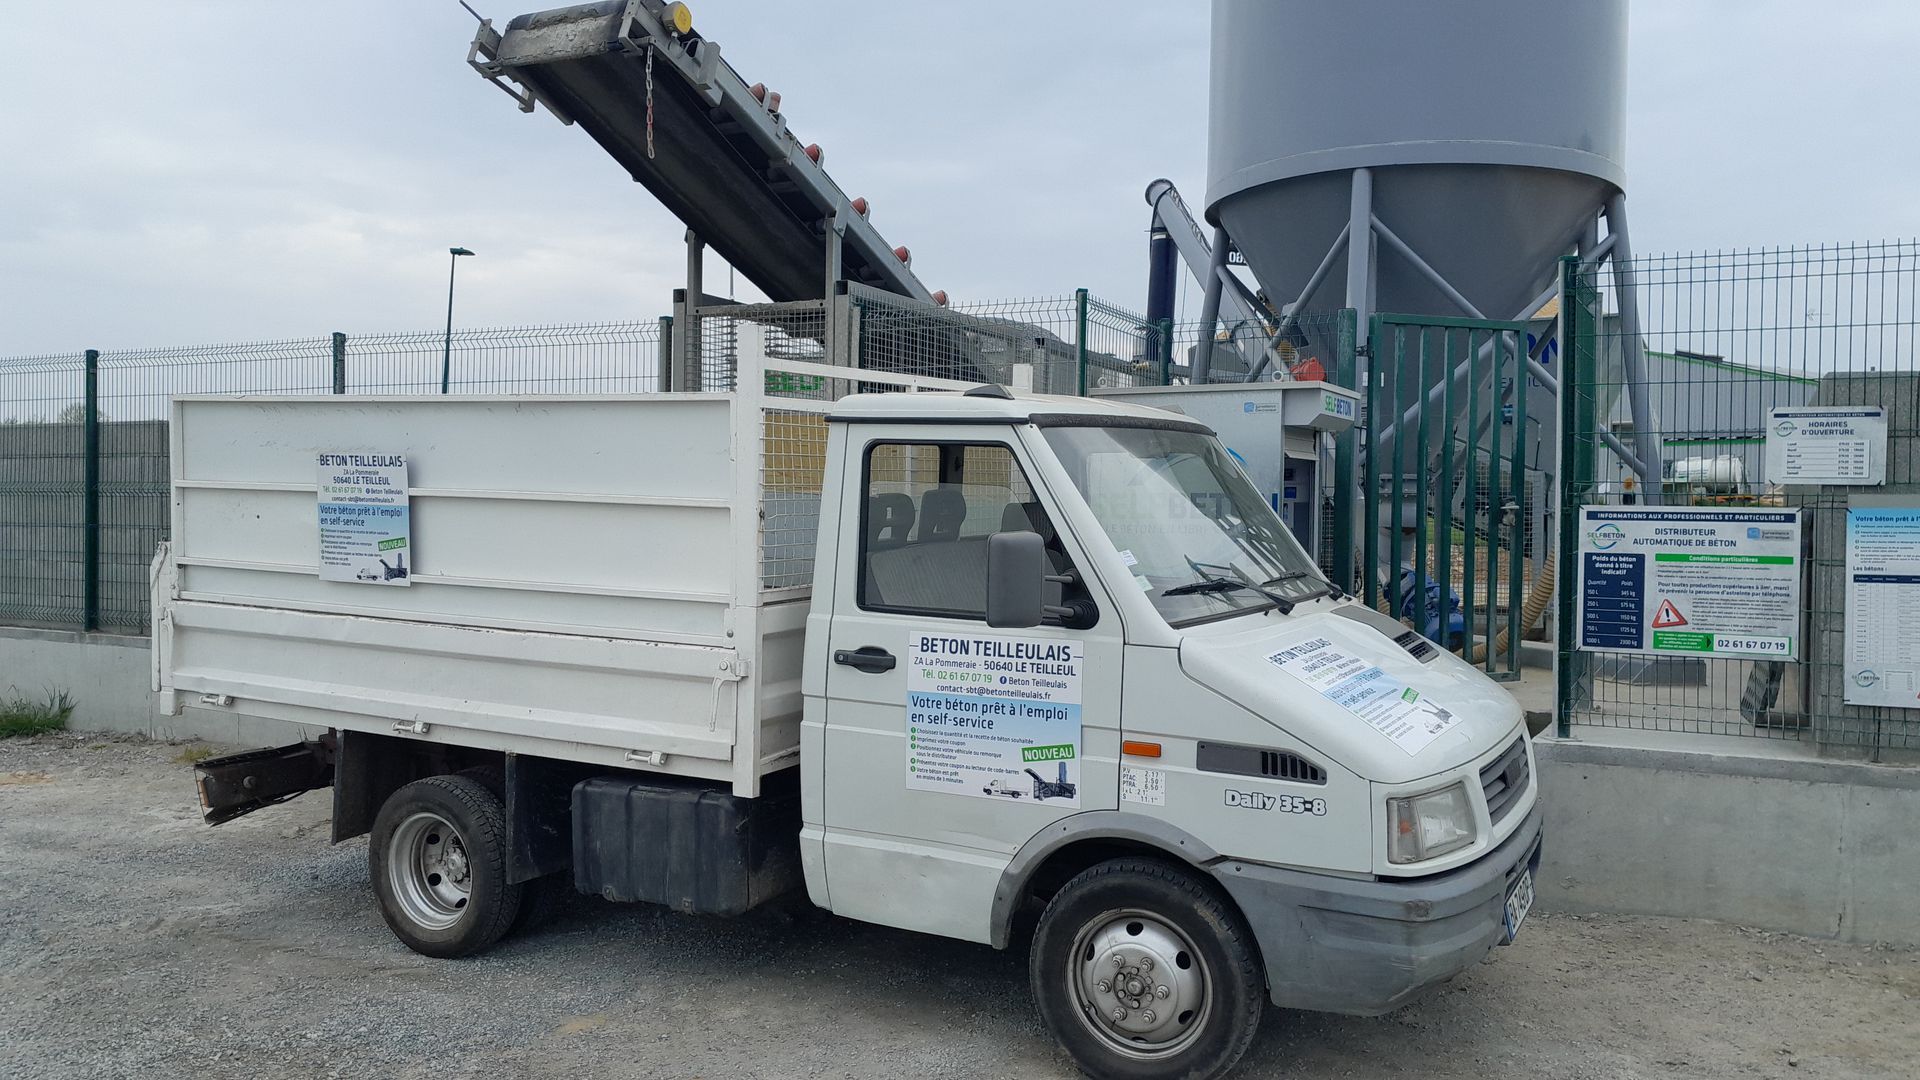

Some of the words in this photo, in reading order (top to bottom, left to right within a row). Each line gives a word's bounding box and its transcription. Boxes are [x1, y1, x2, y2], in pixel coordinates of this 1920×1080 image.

[320, 455, 347, 466] BETON
[349, 455, 403, 467] TEILLEULAIS
[333, 476, 351, 484] 50640
[352, 476, 360, 484] LE
[362, 477, 390, 485] TEILLEUL
[320, 505, 337, 514] Votre
[338, 506, 356, 515] béton
[358, 507, 370, 517] prêt
[377, 507, 402, 518] l'emploi
[329, 517, 365, 527] self-service
[1655, 528, 1716, 536] DISTRIBUTEUR
[379, 539, 406, 550] NOUVEAU
[1633, 538, 1693, 548] AUTOMATIQUE
[1708, 538, 1737, 547] BÉTON
[1721, 555, 1758, 563] particulières
[920, 637, 970, 655] BETON
[973, 640, 1071, 662] TEILLEULAIS
[1718, 639, 1729, 648] 02
[1732, 640, 1743, 648] 61
[1746, 640, 1757, 648] 67
[1760, 641, 1772, 650] 07
[1775, 642, 1785, 650] 19
[914, 657, 924, 665] ZA
[925, 658, 933, 666] La
[935, 658, 977, 669] Pommeraie
[983, 660, 1013, 672] 50640
[1015, 662, 1027, 673] LE
[1029, 663, 1077, 676] TEILLEUL
[922, 668, 936, 679] Tél.
[938, 671, 947, 680] 02
[949, 671, 958, 681] 61
[959, 672, 970, 682] 67
[971, 673, 982, 682] 07
[983, 674, 992, 683] 19
[1008, 676, 1030, 687] Beton
[1032, 678, 1068, 689] Teilleulais
[936, 683, 1051, 700] contact-sbt@betonteilleulais.fr
[911, 696, 942, 710] Votre
[945, 697, 978, 712] béton
[981, 702, 1005, 716] prêt
[1009, 703, 1016, 714] à
[1019, 703, 1068, 722] l'emploi
[911, 713, 924, 723] en
[927, 713, 994, 730] self-service
[1024, 746, 1073, 761] NOUVEAU
[1225, 789, 1276, 811] Daily
[1280, 795, 1327, 816] 35-8
